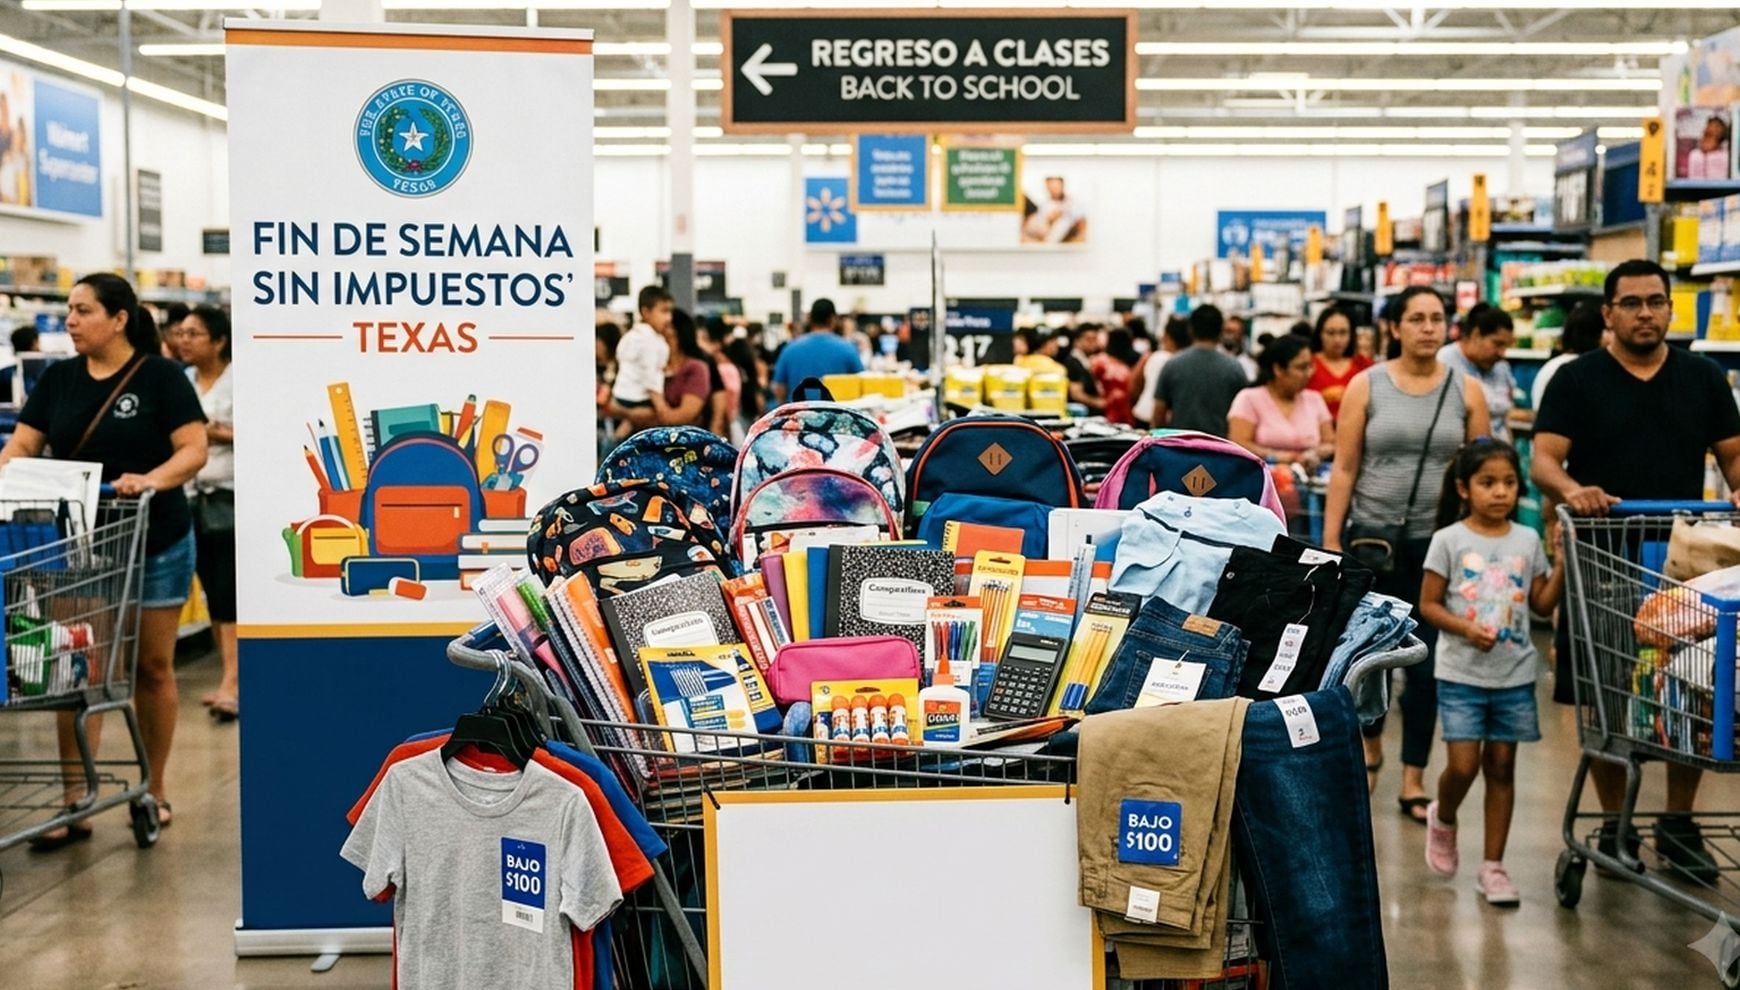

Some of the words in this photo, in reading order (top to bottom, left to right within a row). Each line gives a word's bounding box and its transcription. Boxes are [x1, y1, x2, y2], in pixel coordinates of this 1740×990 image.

[811, 39, 958, 67] REGRESO
[963, 39, 988, 66] A
[993, 39, 1110, 67] CLASES
[841, 75, 914, 100] BACK
[919, 75, 957, 100] TO
[963, 75, 1080, 100] SCHOOL
[253, 221, 319, 256] FIN
[333, 222, 387, 257] DE
[398, 223, 574, 258] SEMANA
[253, 270, 319, 306] SIN
[353, 321, 478, 354] TEXAS
[1128, 813, 1173, 830] BAJO
[1126, 831, 1172, 852] $100
[506, 854, 540, 873] BAJO
[506, 871, 541, 895] $100
